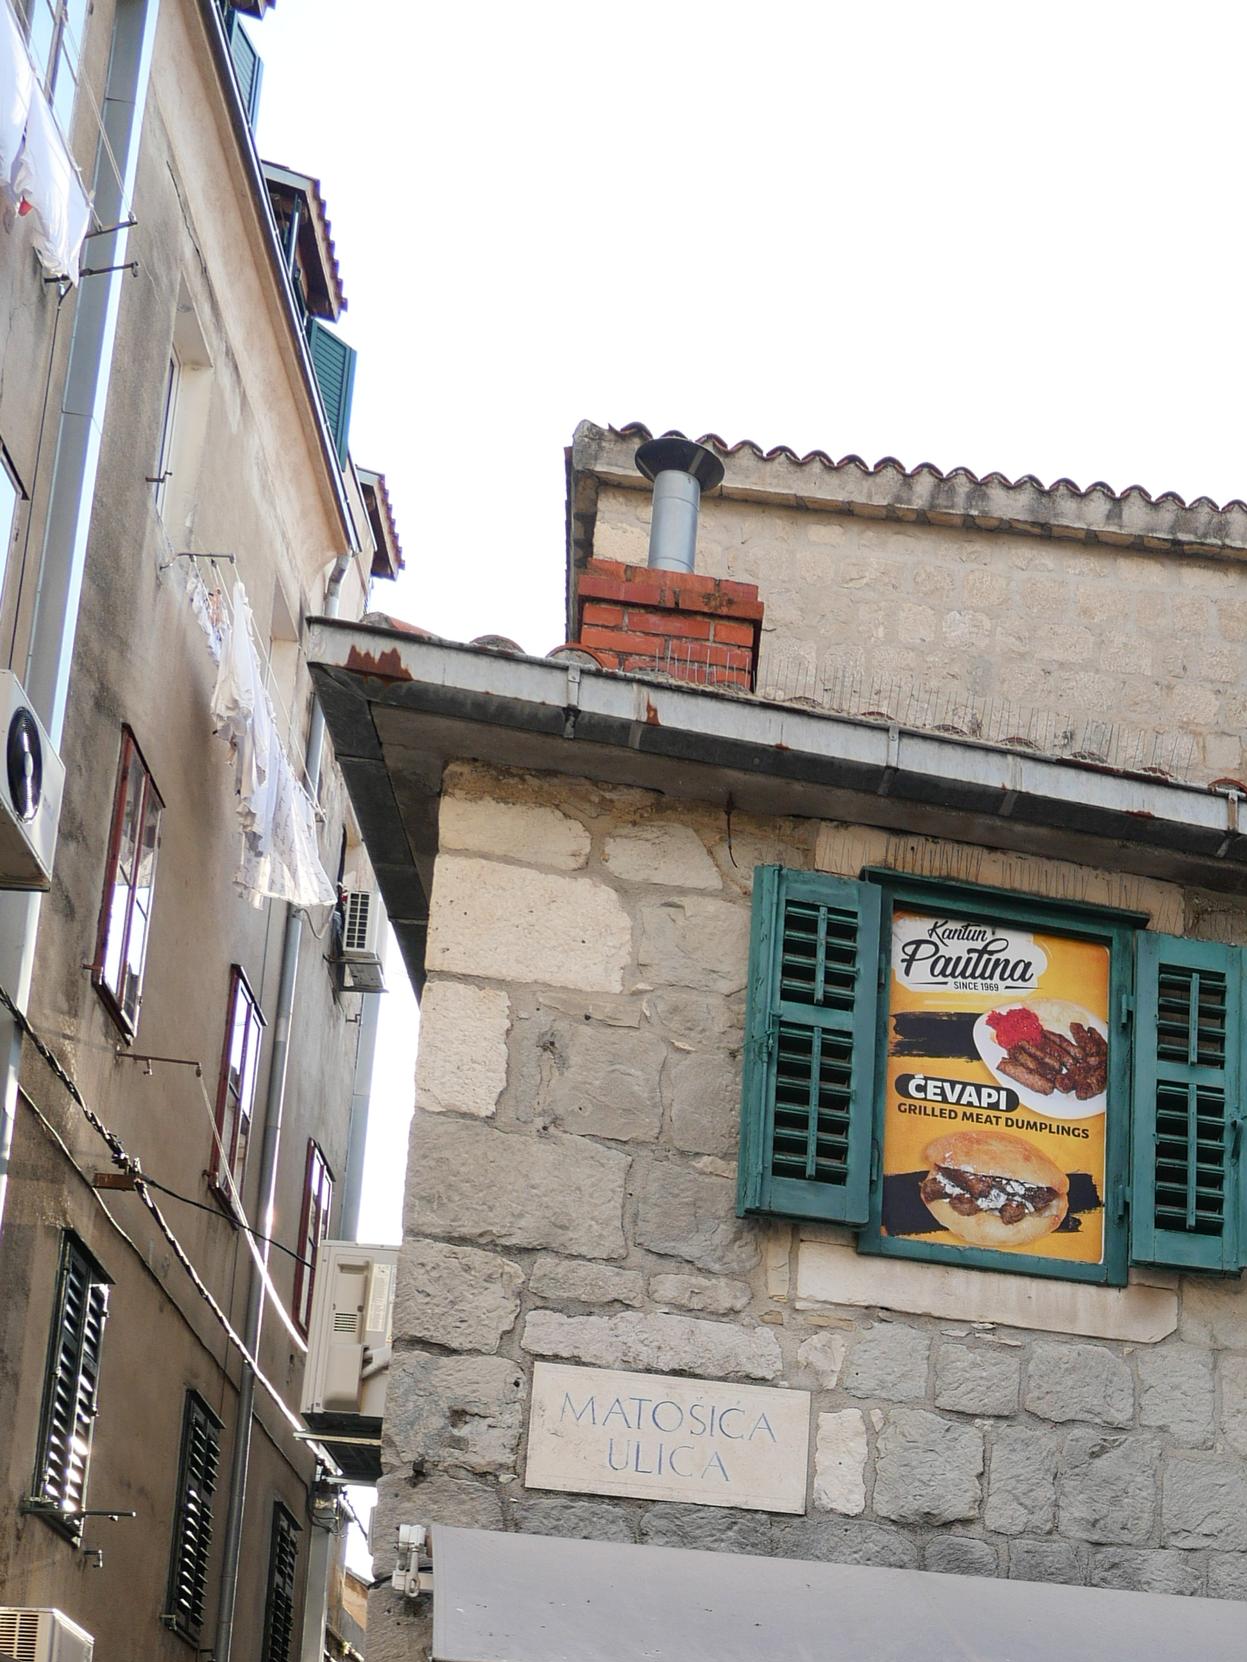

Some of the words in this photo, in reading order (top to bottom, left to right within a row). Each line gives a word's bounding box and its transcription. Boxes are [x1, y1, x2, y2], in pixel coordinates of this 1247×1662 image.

[927, 920, 987, 947] Kantun
[900, 938, 1033, 982] Paulina
[954, 981, 978, 991] SINCE
[981, 982, 999, 992] 1969
[898, 1102, 958, 1120] GRILLED
[961, 1111, 1002, 1127] MEAT
[1005, 1117, 1090, 1139] DUMPLINGS
[608, 1438, 730, 1481] ULICA
